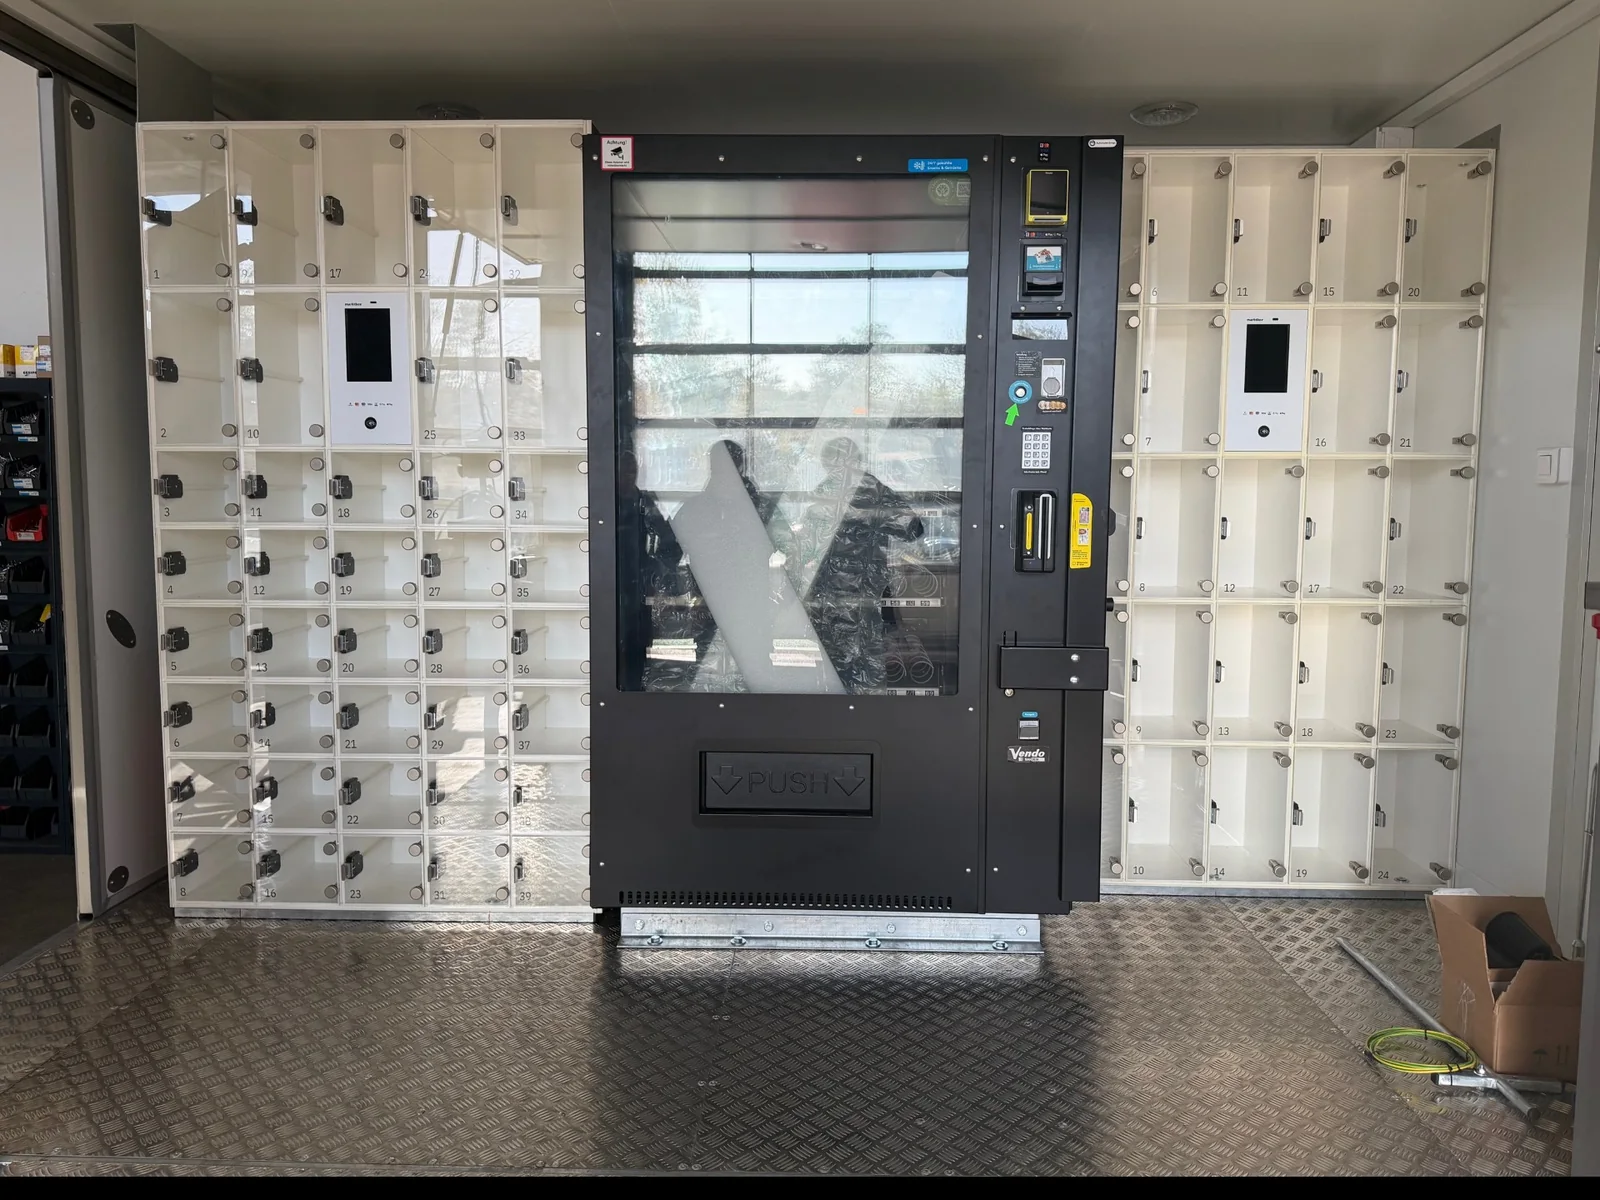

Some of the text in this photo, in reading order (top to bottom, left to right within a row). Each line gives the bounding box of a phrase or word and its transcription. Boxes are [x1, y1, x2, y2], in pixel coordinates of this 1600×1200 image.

[154, 270, 160, 279] 1
[242, 270, 248, 278] 9
[329, 268, 342, 278] 17
[419, 269, 431, 278] 24
[508, 269, 521, 279] 32
[1152, 287, 1158, 296] 6
[1236, 287, 1248, 296] 11
[1323, 287, 1335, 296] 15
[1408, 287, 1420, 297] 20
[160, 428, 167, 438] 2
[247, 429, 259, 438] 10
[424, 429, 437, 440] 25
[513, 431, 526, 440] 33
[1146, 437, 1152, 446] 7
[1315, 438, 1326, 447] 16
[1399, 438, 1411, 447] 21
[164, 507, 170, 517] 3
[250, 507, 262, 517] 11
[338, 508, 350, 518] 18
[426, 510, 439, 519] 26
[515, 510, 527, 519] 34
[167, 586, 173, 594] 4
[253, 586, 265, 595] 12
[340, 586, 352, 595] 19
[428, 587, 440, 596] 27
[1139, 583, 1145, 591] 8
[1224, 584, 1235, 593] 12
[1308, 584, 1319, 593] 17
[1392, 586, 1404, 594] 22
[516, 588, 529, 597] 35
[171, 661, 177, 671] 5
[256, 663, 268, 672] 13
[342, 663, 354, 673] 20
[430, 664, 443, 673] 28
[517, 664, 530, 674] 36
[1136, 726, 1141, 734] 9
[1218, 727, 1230, 736] 13
[1302, 728, 1313, 736] 18
[1385, 730, 1397, 738] 23
[174, 738, 180, 747] 6
[259, 739, 271, 747] 14
[345, 740, 357, 749] 21
[431, 740, 444, 749] 29
[518, 741, 530, 750] 37
[1009, 746, 1045, 760] Vendo
[748, 772, 828, 794] PUSH
[177, 813, 183, 822] 7
[262, 814, 273, 823] 15
[347, 815, 359, 824] 22
[433, 816, 445, 825] 30
[1132, 866, 1145, 875] 10
[1214, 867, 1225, 876] 14
[1296, 869, 1307, 878] 19
[1378, 870, 1389, 880] 24
[180, 887, 186, 896] 8
[265, 888, 276, 897] 16
[350, 890, 362, 899] 23
[434, 891, 446, 900] 31
[520, 892, 531, 901] 39
